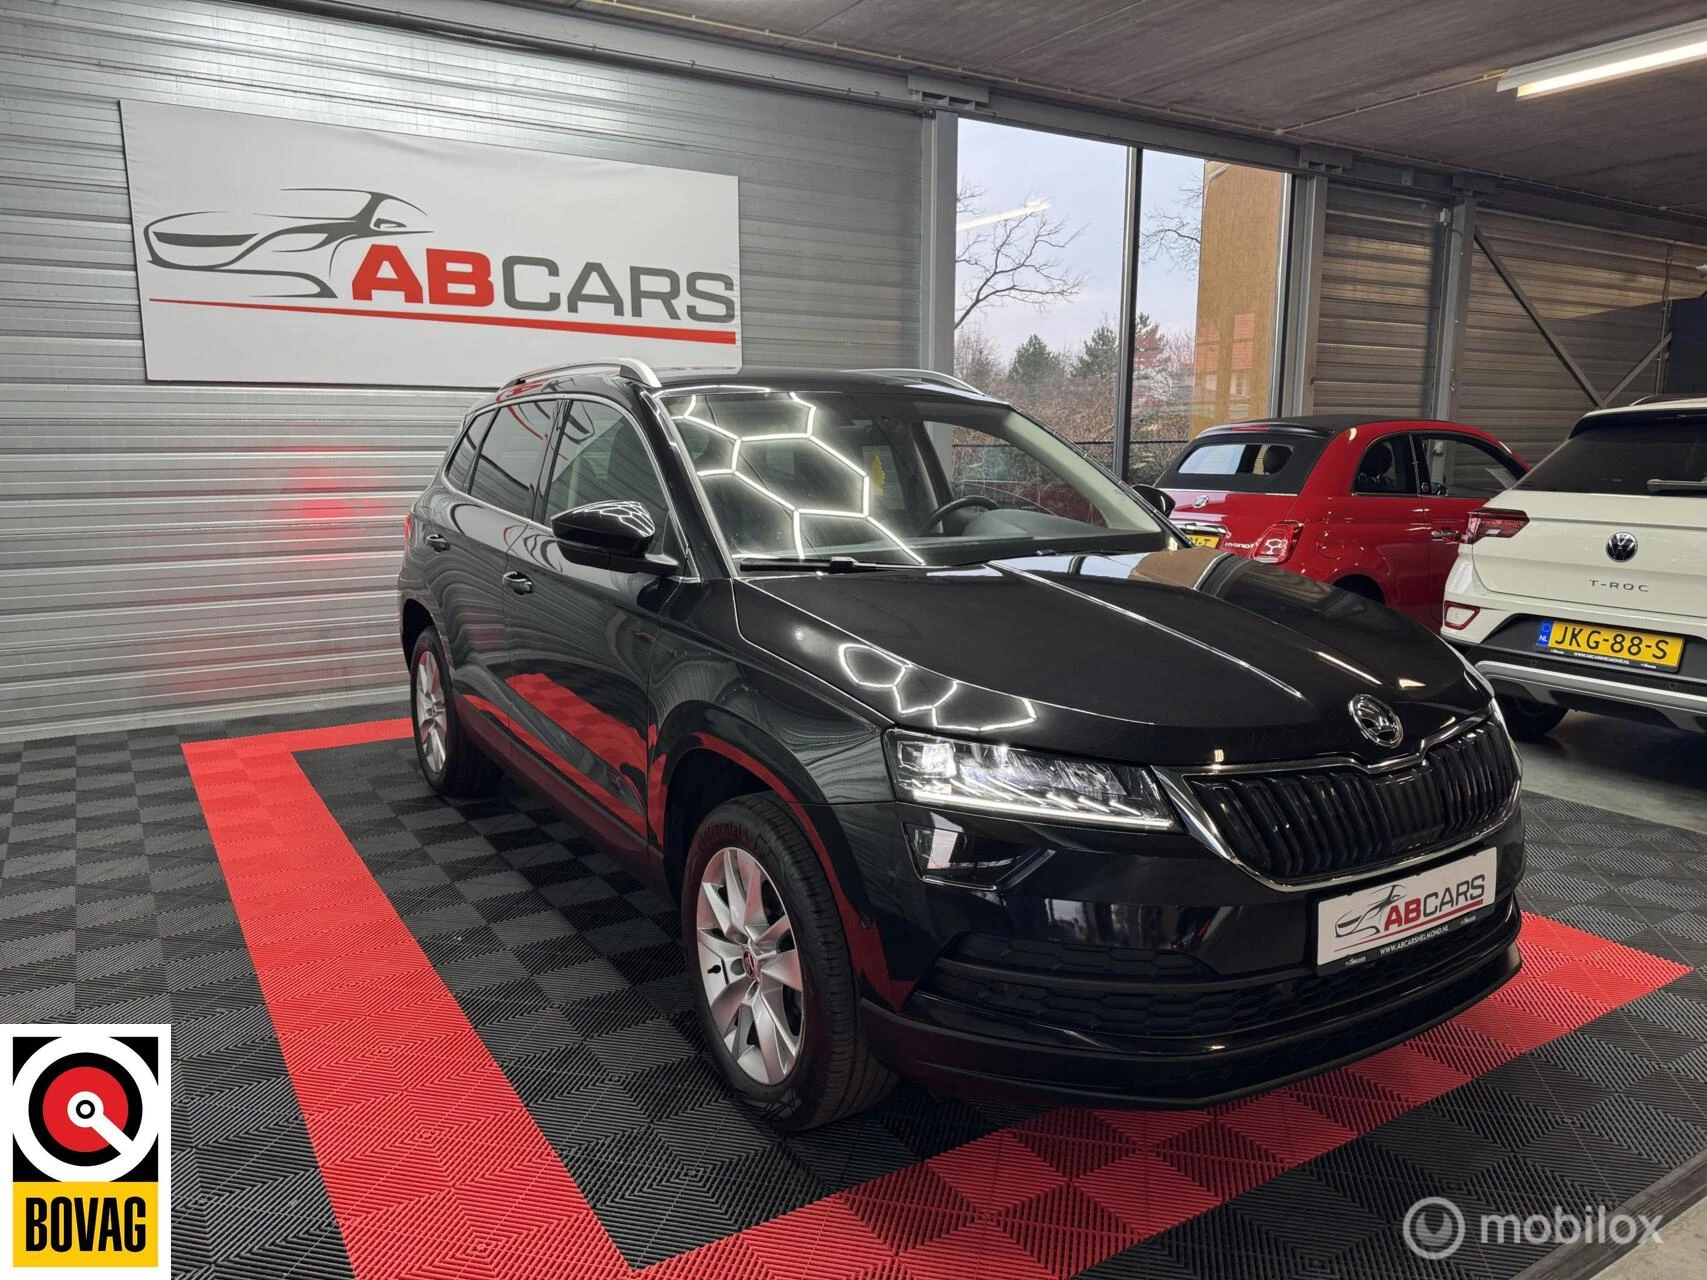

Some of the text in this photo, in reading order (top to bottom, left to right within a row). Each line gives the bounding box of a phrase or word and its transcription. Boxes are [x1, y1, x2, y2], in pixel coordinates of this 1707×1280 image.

[351, 243, 736, 323] ABCARS
[1589, 579, 1649, 592] T-ROC
[1538, 634, 1548, 642] NL
[1555, 626, 1669, 660] JKG-88-S
[1384, 873, 1486, 932] ABCARS
